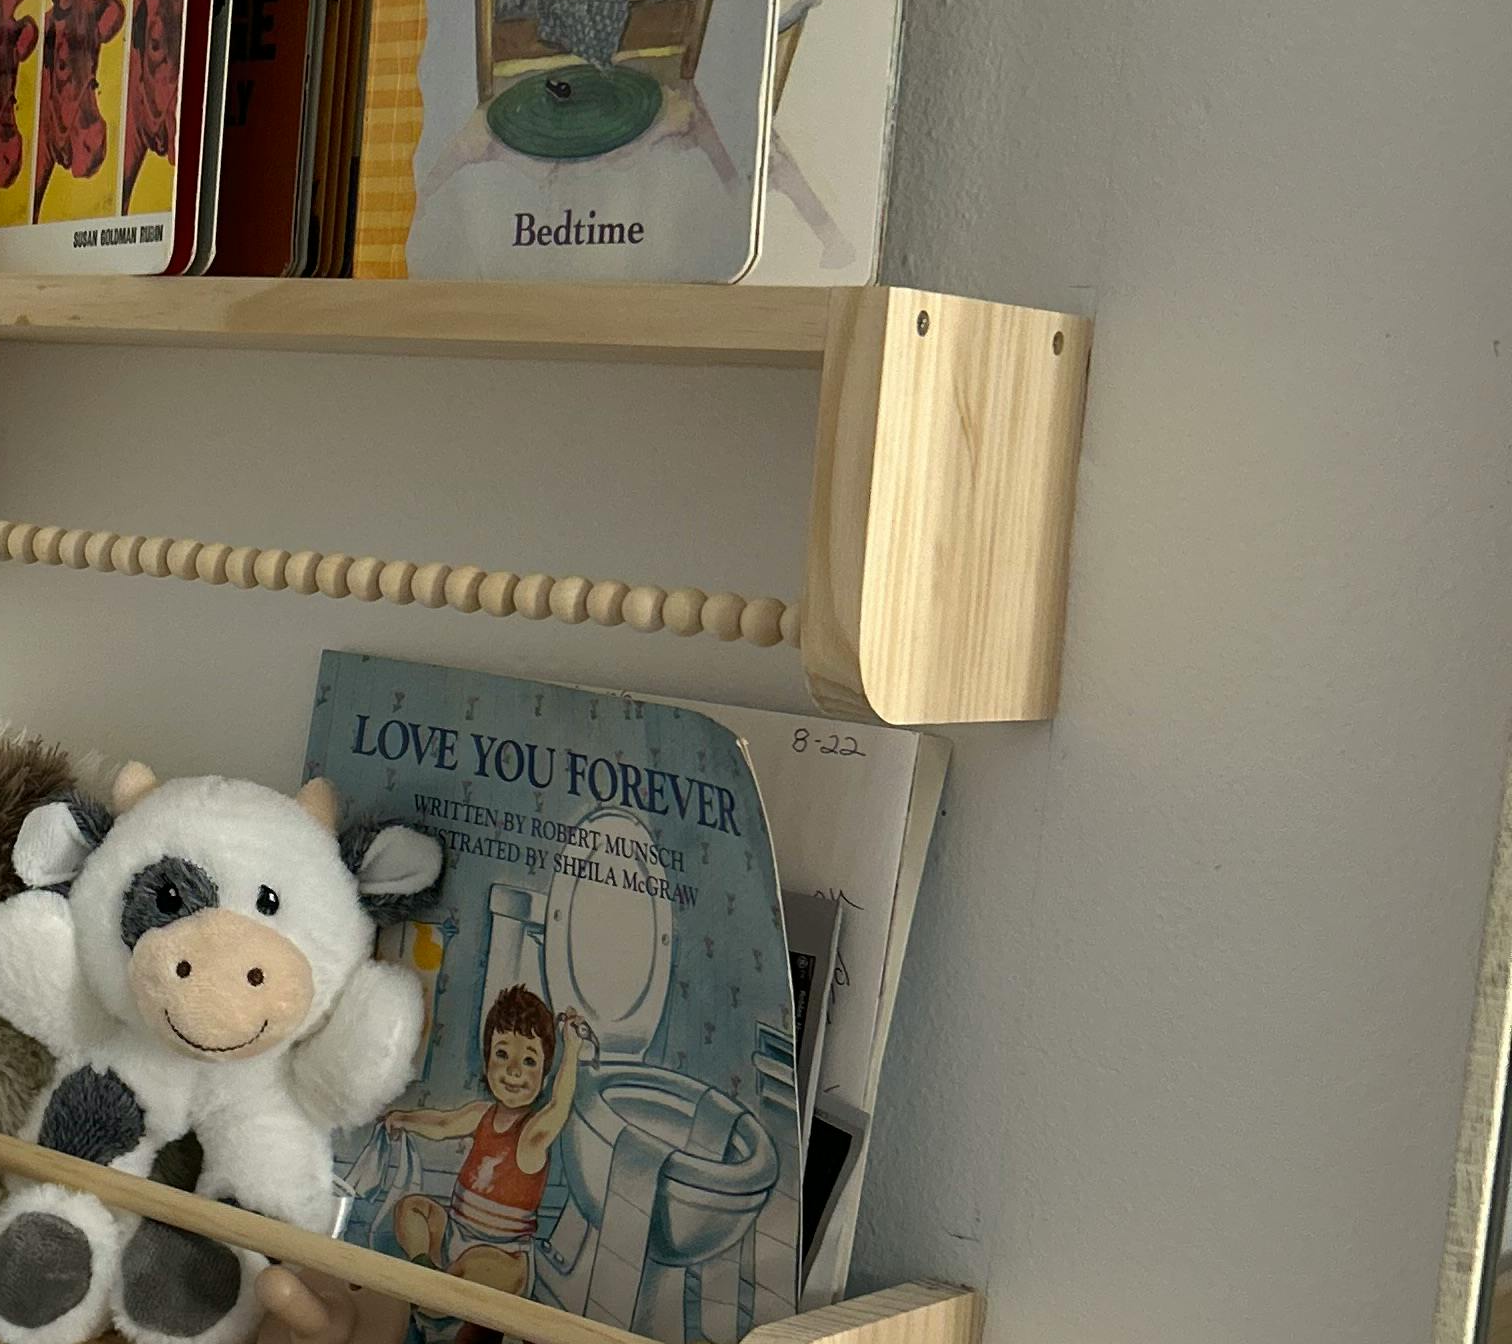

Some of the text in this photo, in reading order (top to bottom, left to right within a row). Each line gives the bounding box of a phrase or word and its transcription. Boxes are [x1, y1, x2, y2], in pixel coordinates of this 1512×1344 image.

[73, 229, 98, 249] SUSAN
[100, 226, 138, 247] GOLDMAN
[512, 209, 645, 248] Bedtime
[791, 728, 866, 757] 8-22
[351, 714, 741, 838] LOVE YOU FOREVER
[414, 793, 686, 873] WRITTEN BY ROBERT MUNSCH
[525, 847, 549, 870] BY
[553, 854, 617, 887] SHEILA
[622, 868, 699, 908] McGRAW
